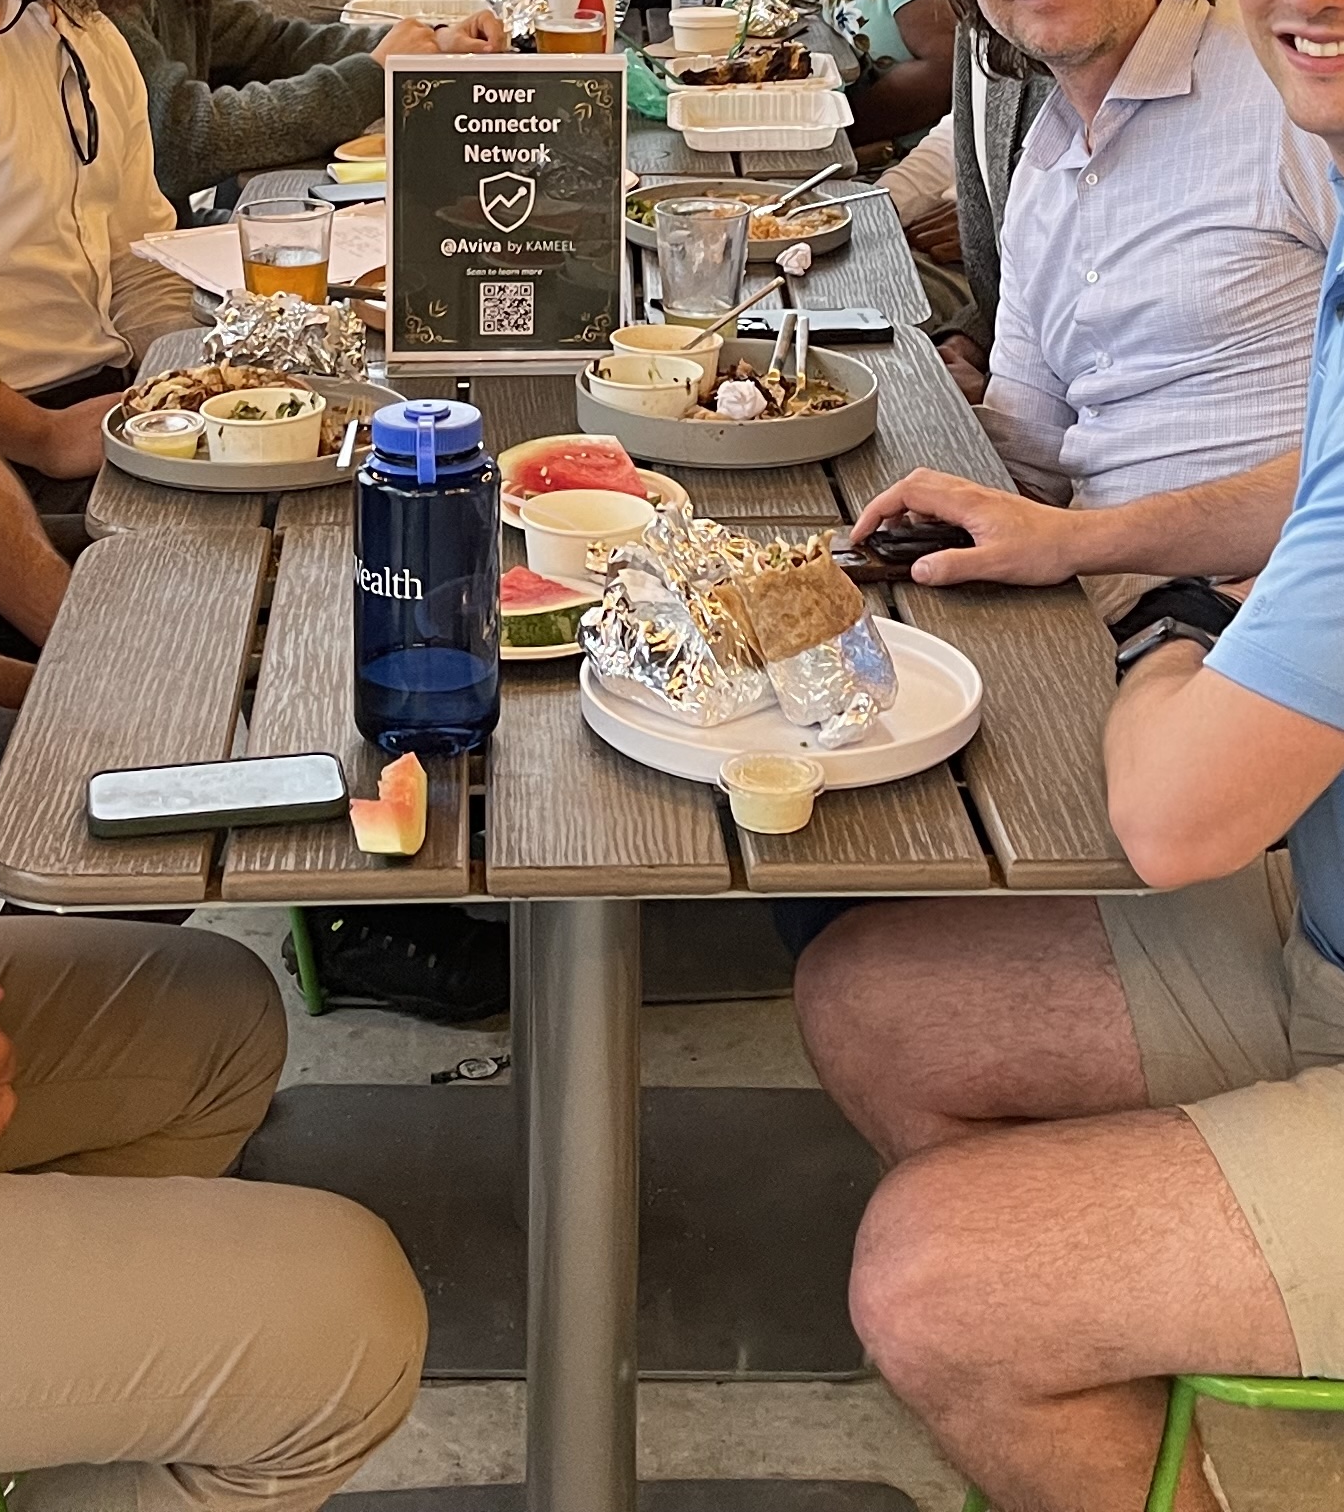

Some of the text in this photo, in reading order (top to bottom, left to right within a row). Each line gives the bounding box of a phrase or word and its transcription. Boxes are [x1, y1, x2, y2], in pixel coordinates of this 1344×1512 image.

[472, 84, 536, 104] Power
[453, 114, 562, 134] Connector
[464, 143, 552, 163] Network
[440, 238, 577, 257] @Aviva by KAMEEL
[466, 267, 543, 276] Scan to learn more
